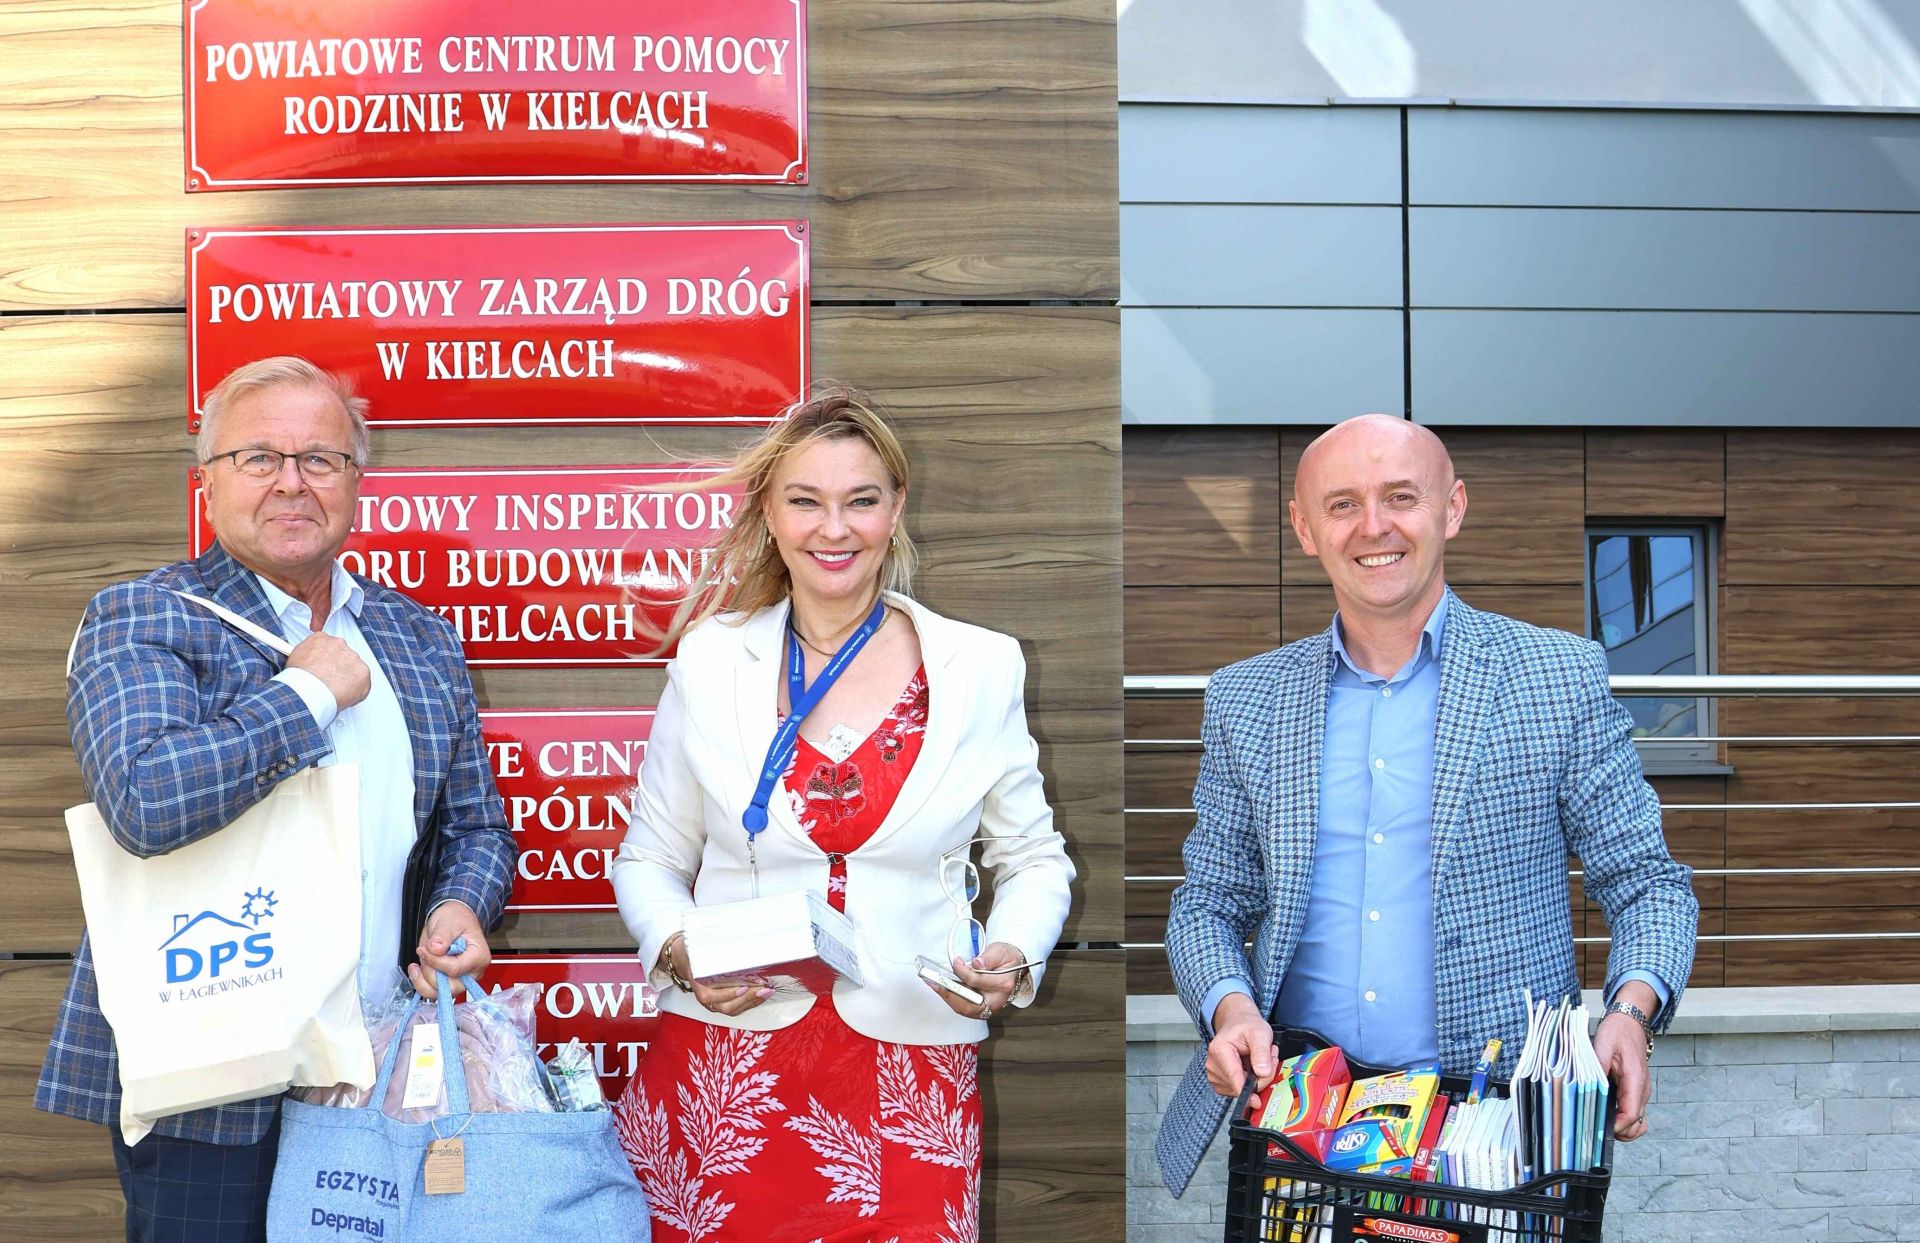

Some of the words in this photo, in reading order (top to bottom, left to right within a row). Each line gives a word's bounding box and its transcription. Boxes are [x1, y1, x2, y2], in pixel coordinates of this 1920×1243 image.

[206, 38, 423, 82] POWIATOWE
[438, 35, 616, 74] CENTRUM
[632, 35, 791, 76] POMOCY
[283, 93, 465, 135] RODZINIE
[478, 92, 511, 131] W
[527, 90, 709, 130] KIELCACH
[208, 280, 462, 323] POWIATOWY
[478, 277, 648, 325] ZARZĄD
[666, 266, 790, 316] DRÓG
[376, 341, 409, 381] W
[425, 339, 615, 381] KIELCACH
[350, 495, 478, 533] TOWY
[494, 492, 736, 531] INSPEKTOR
[428, 603, 636, 642] IELCACH
[501, 785, 636, 832] PÓLN
[513, 848, 614, 881] CAC
[165, 932, 274, 984] DPS
[159, 991, 172, 1003] W
[179, 967, 283, 1001] ŁAGIEWNIKACH
[316, 1170, 399, 1203] EGZYSTA
[311, 1207, 384, 1238] Depratal
[1378, 1221, 1445, 1242] PAPADIMAS
